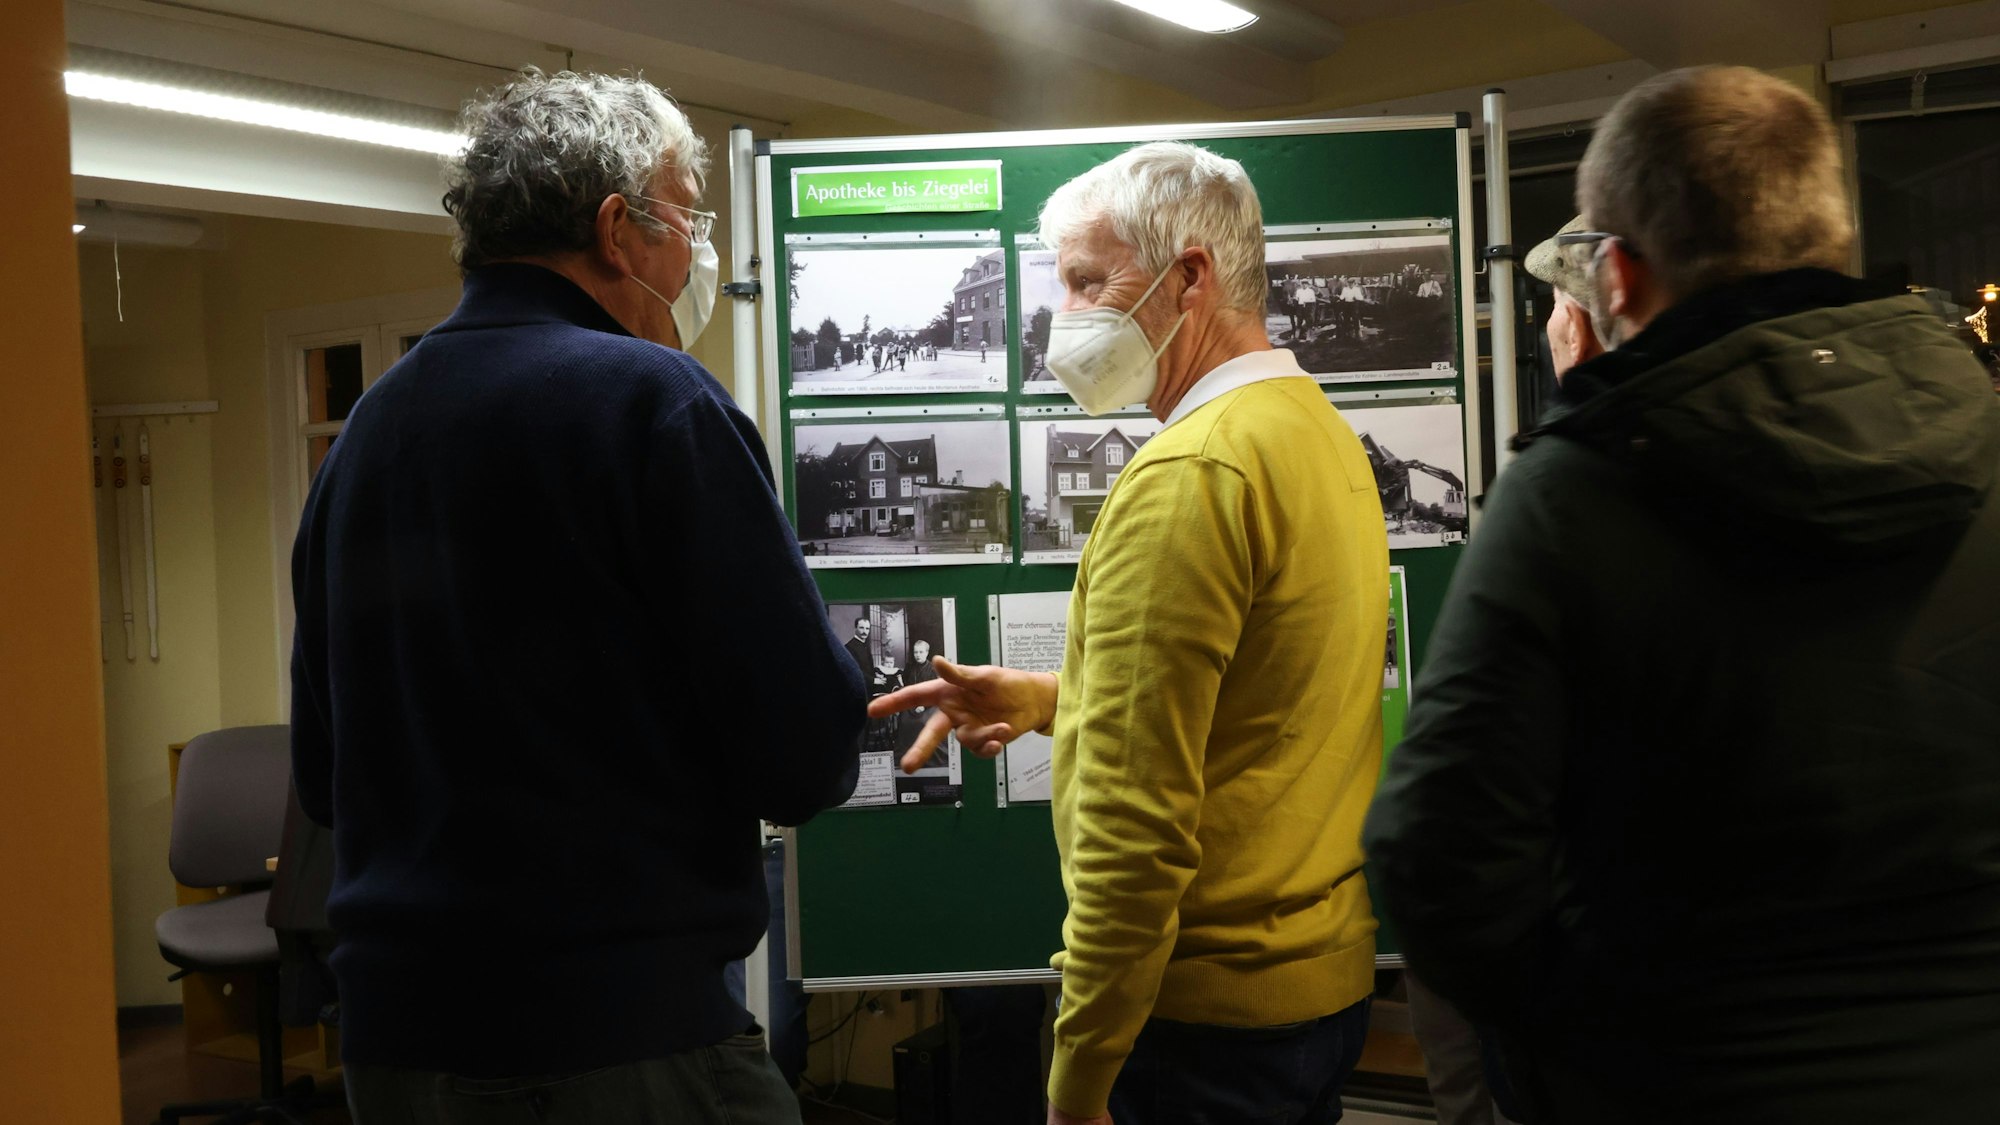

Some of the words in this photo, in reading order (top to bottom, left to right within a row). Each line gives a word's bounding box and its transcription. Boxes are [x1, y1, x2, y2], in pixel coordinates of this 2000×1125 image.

[805, 182, 886, 204] Apotheke
[892, 181, 916, 197] bis
[922, 178, 989, 200] Ziegelei
